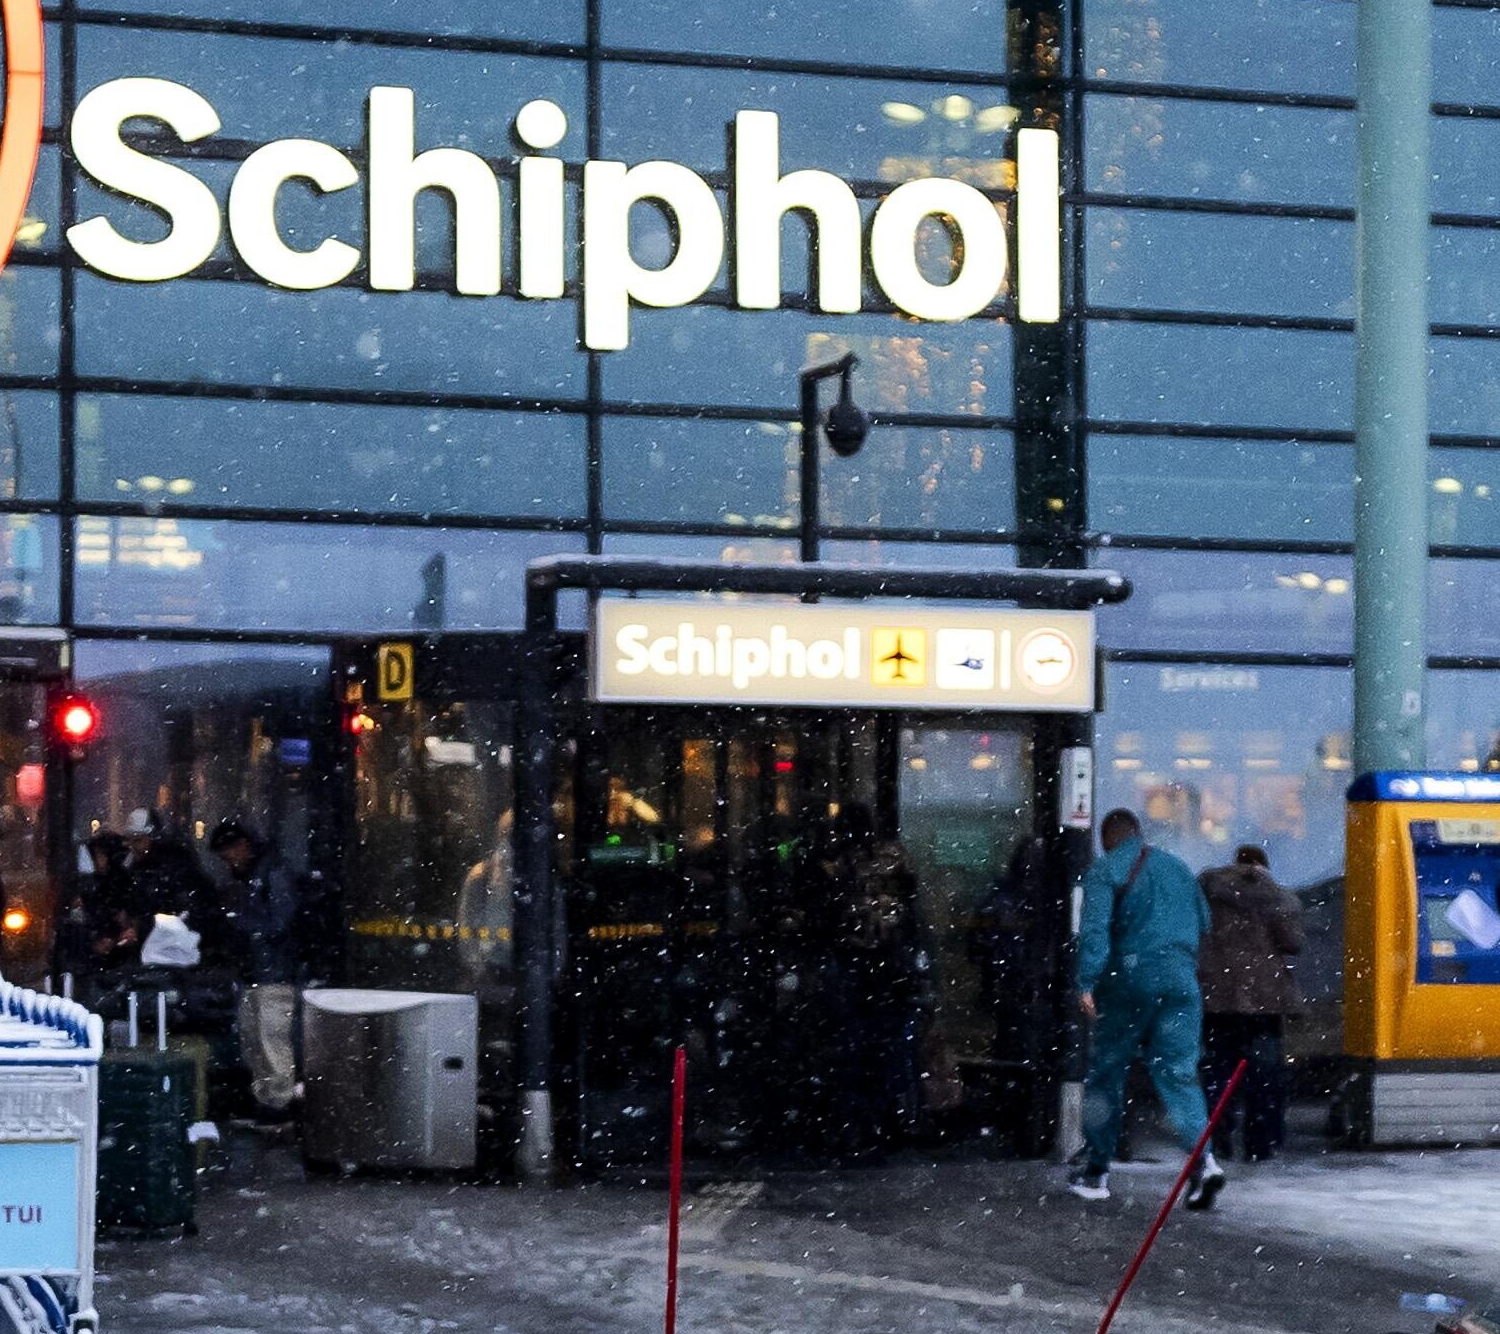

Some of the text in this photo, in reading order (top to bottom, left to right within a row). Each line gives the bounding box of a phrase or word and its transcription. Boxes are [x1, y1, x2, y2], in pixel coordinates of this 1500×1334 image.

[66, 76, 1061, 351] Schiphol
[384, 649, 407, 692] D
[614, 622, 861, 689] Schiphol
[2, 1204, 43, 1224] TUI
